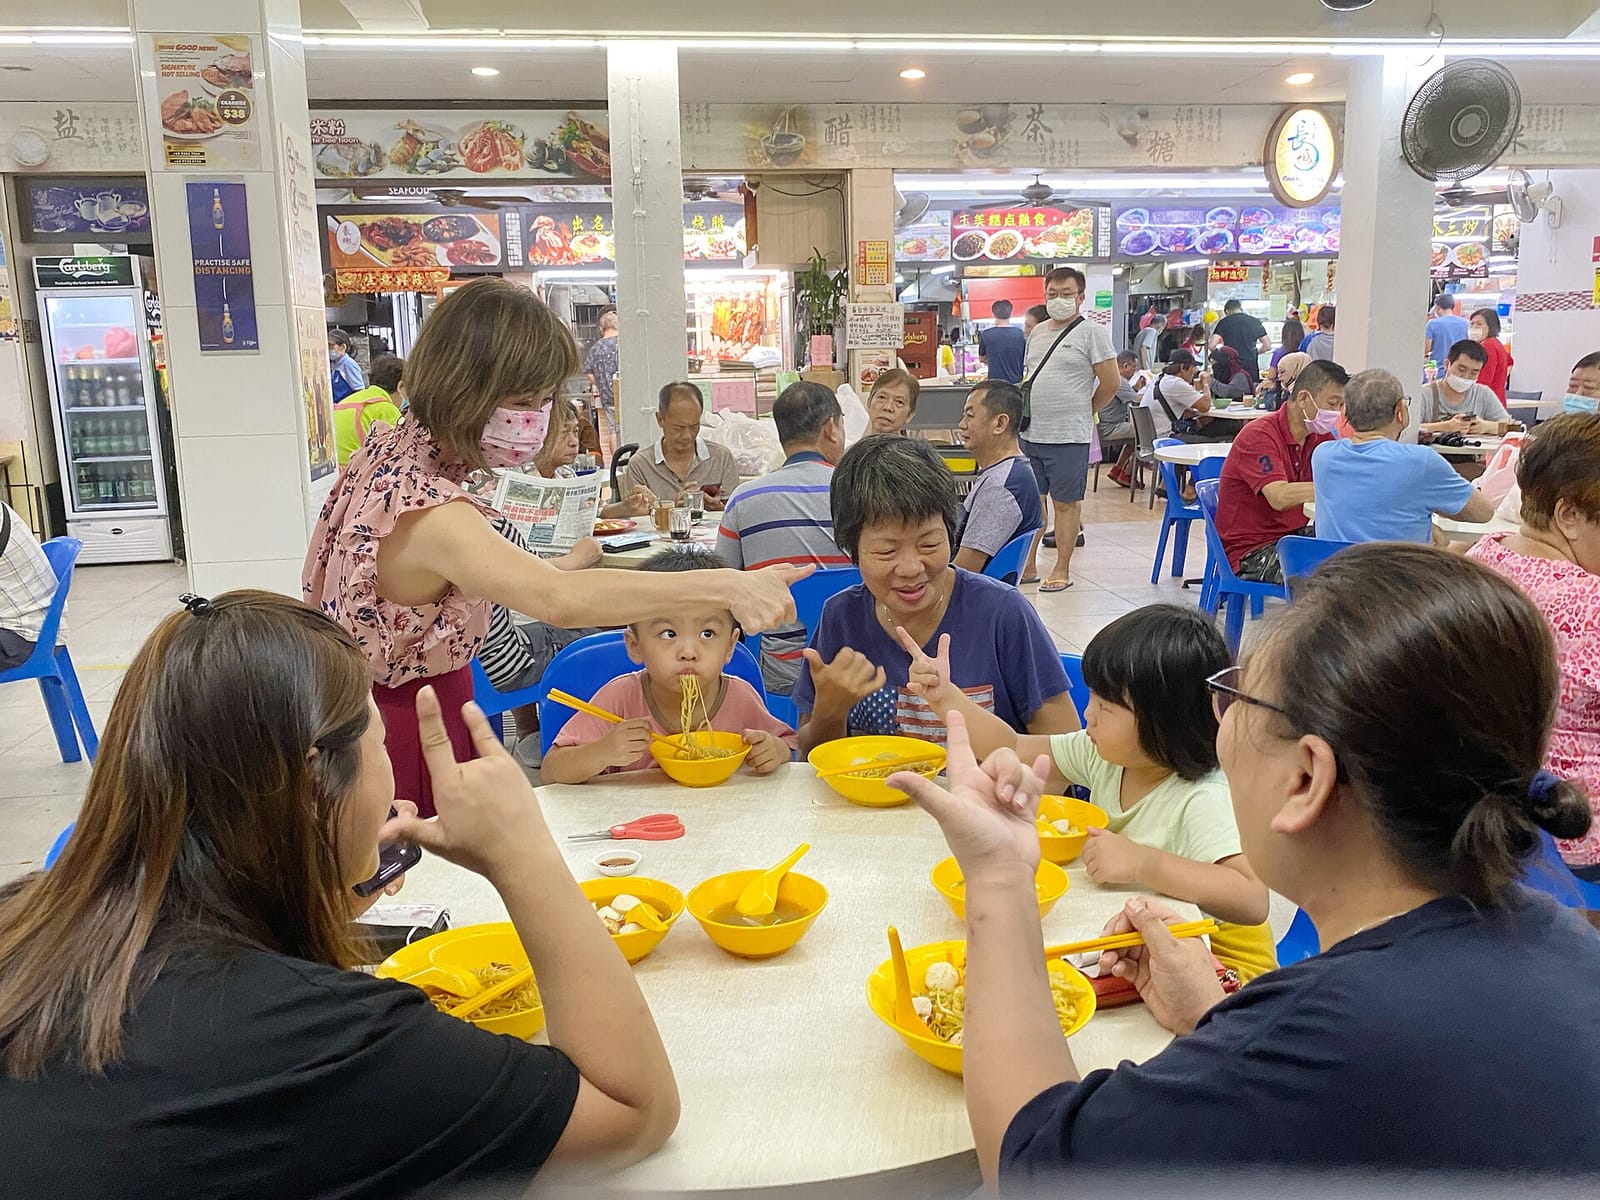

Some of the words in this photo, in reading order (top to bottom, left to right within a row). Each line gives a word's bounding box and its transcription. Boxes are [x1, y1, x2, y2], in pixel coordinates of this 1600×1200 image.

[223, 109, 246, 119] $38
[1020, 103, 1053, 143] 茶
[52, 109, 84, 141] 盐
[310, 118, 345, 136] 米粉
[823, 112, 853, 147] 醋
[388, 187, 431, 195] SEAFOOD
[59, 258, 110, 275] Carlsberg
[195, 266, 251, 276] DISTANCING
[1258, 455, 1274, 474] 3
